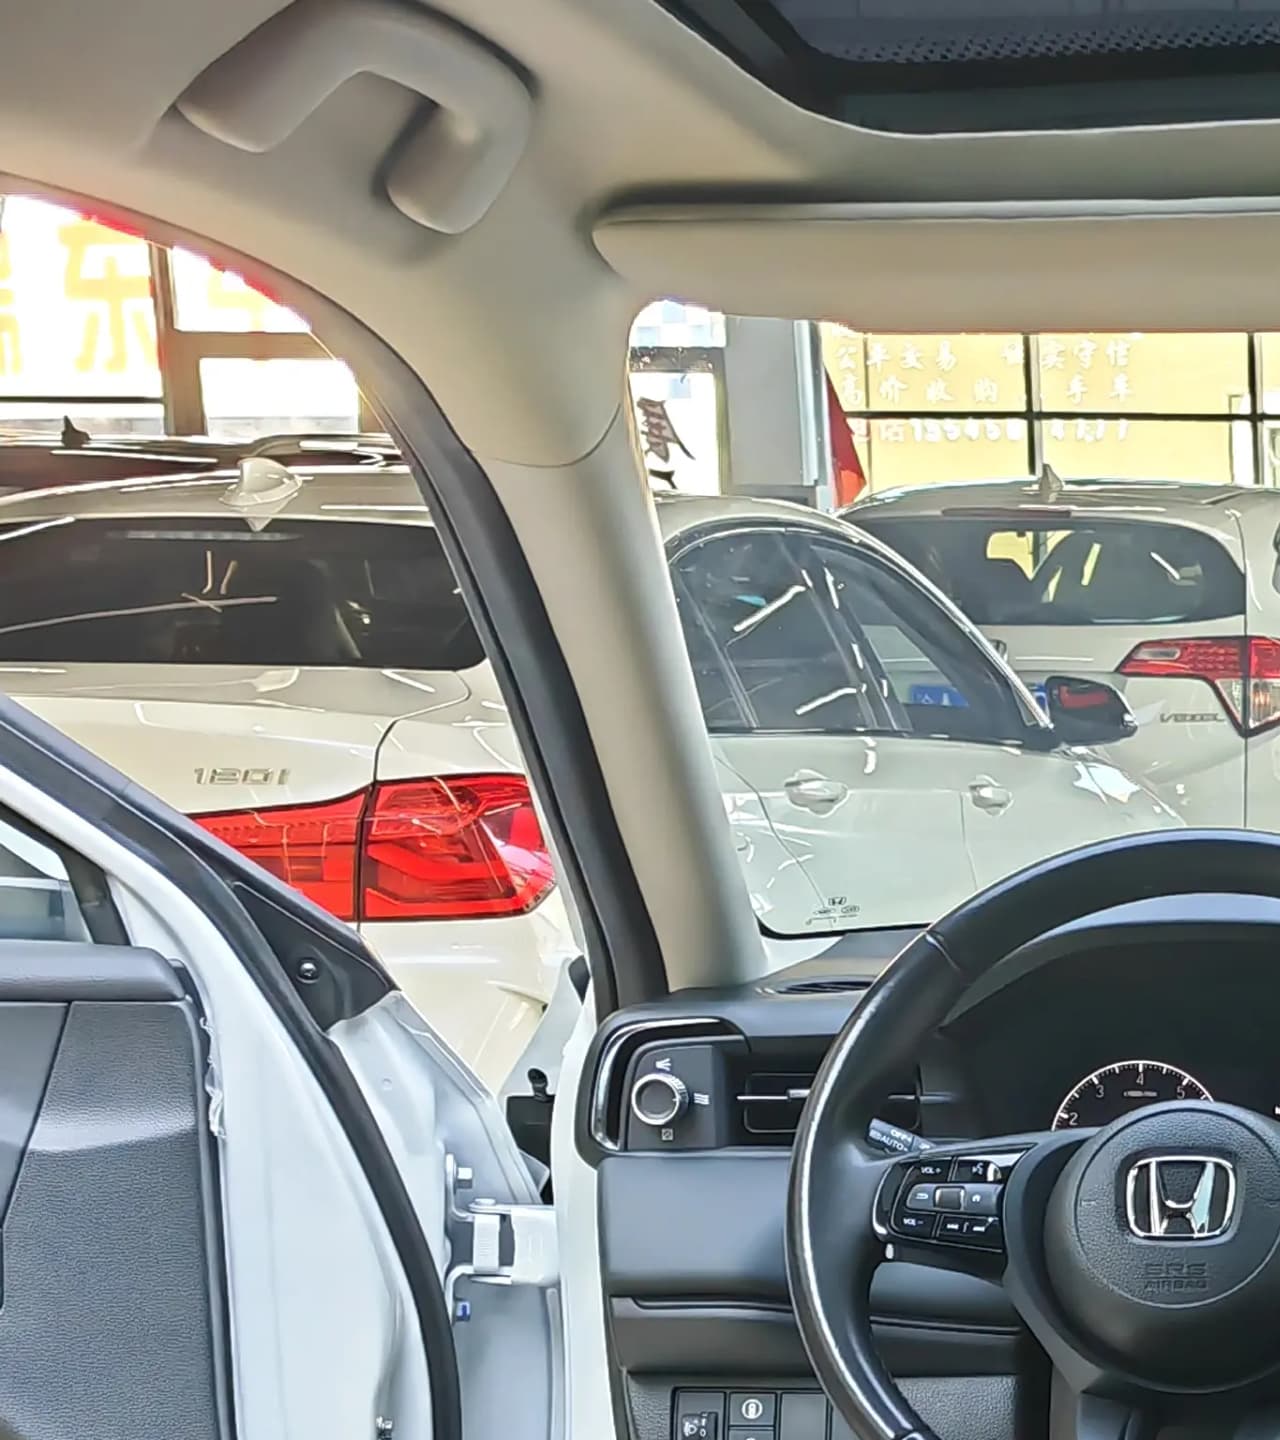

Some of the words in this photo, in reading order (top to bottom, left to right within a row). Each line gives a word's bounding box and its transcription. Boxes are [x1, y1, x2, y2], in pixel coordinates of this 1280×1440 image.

[1136, 1073, 1145, 1086] 4
[1096, 1085, 1105, 1098] 3
[1176, 1086, 1185, 1099] 5
[1068, 1113, 1079, 1126] 2
[882, 1135, 904, 1151] AUTO
